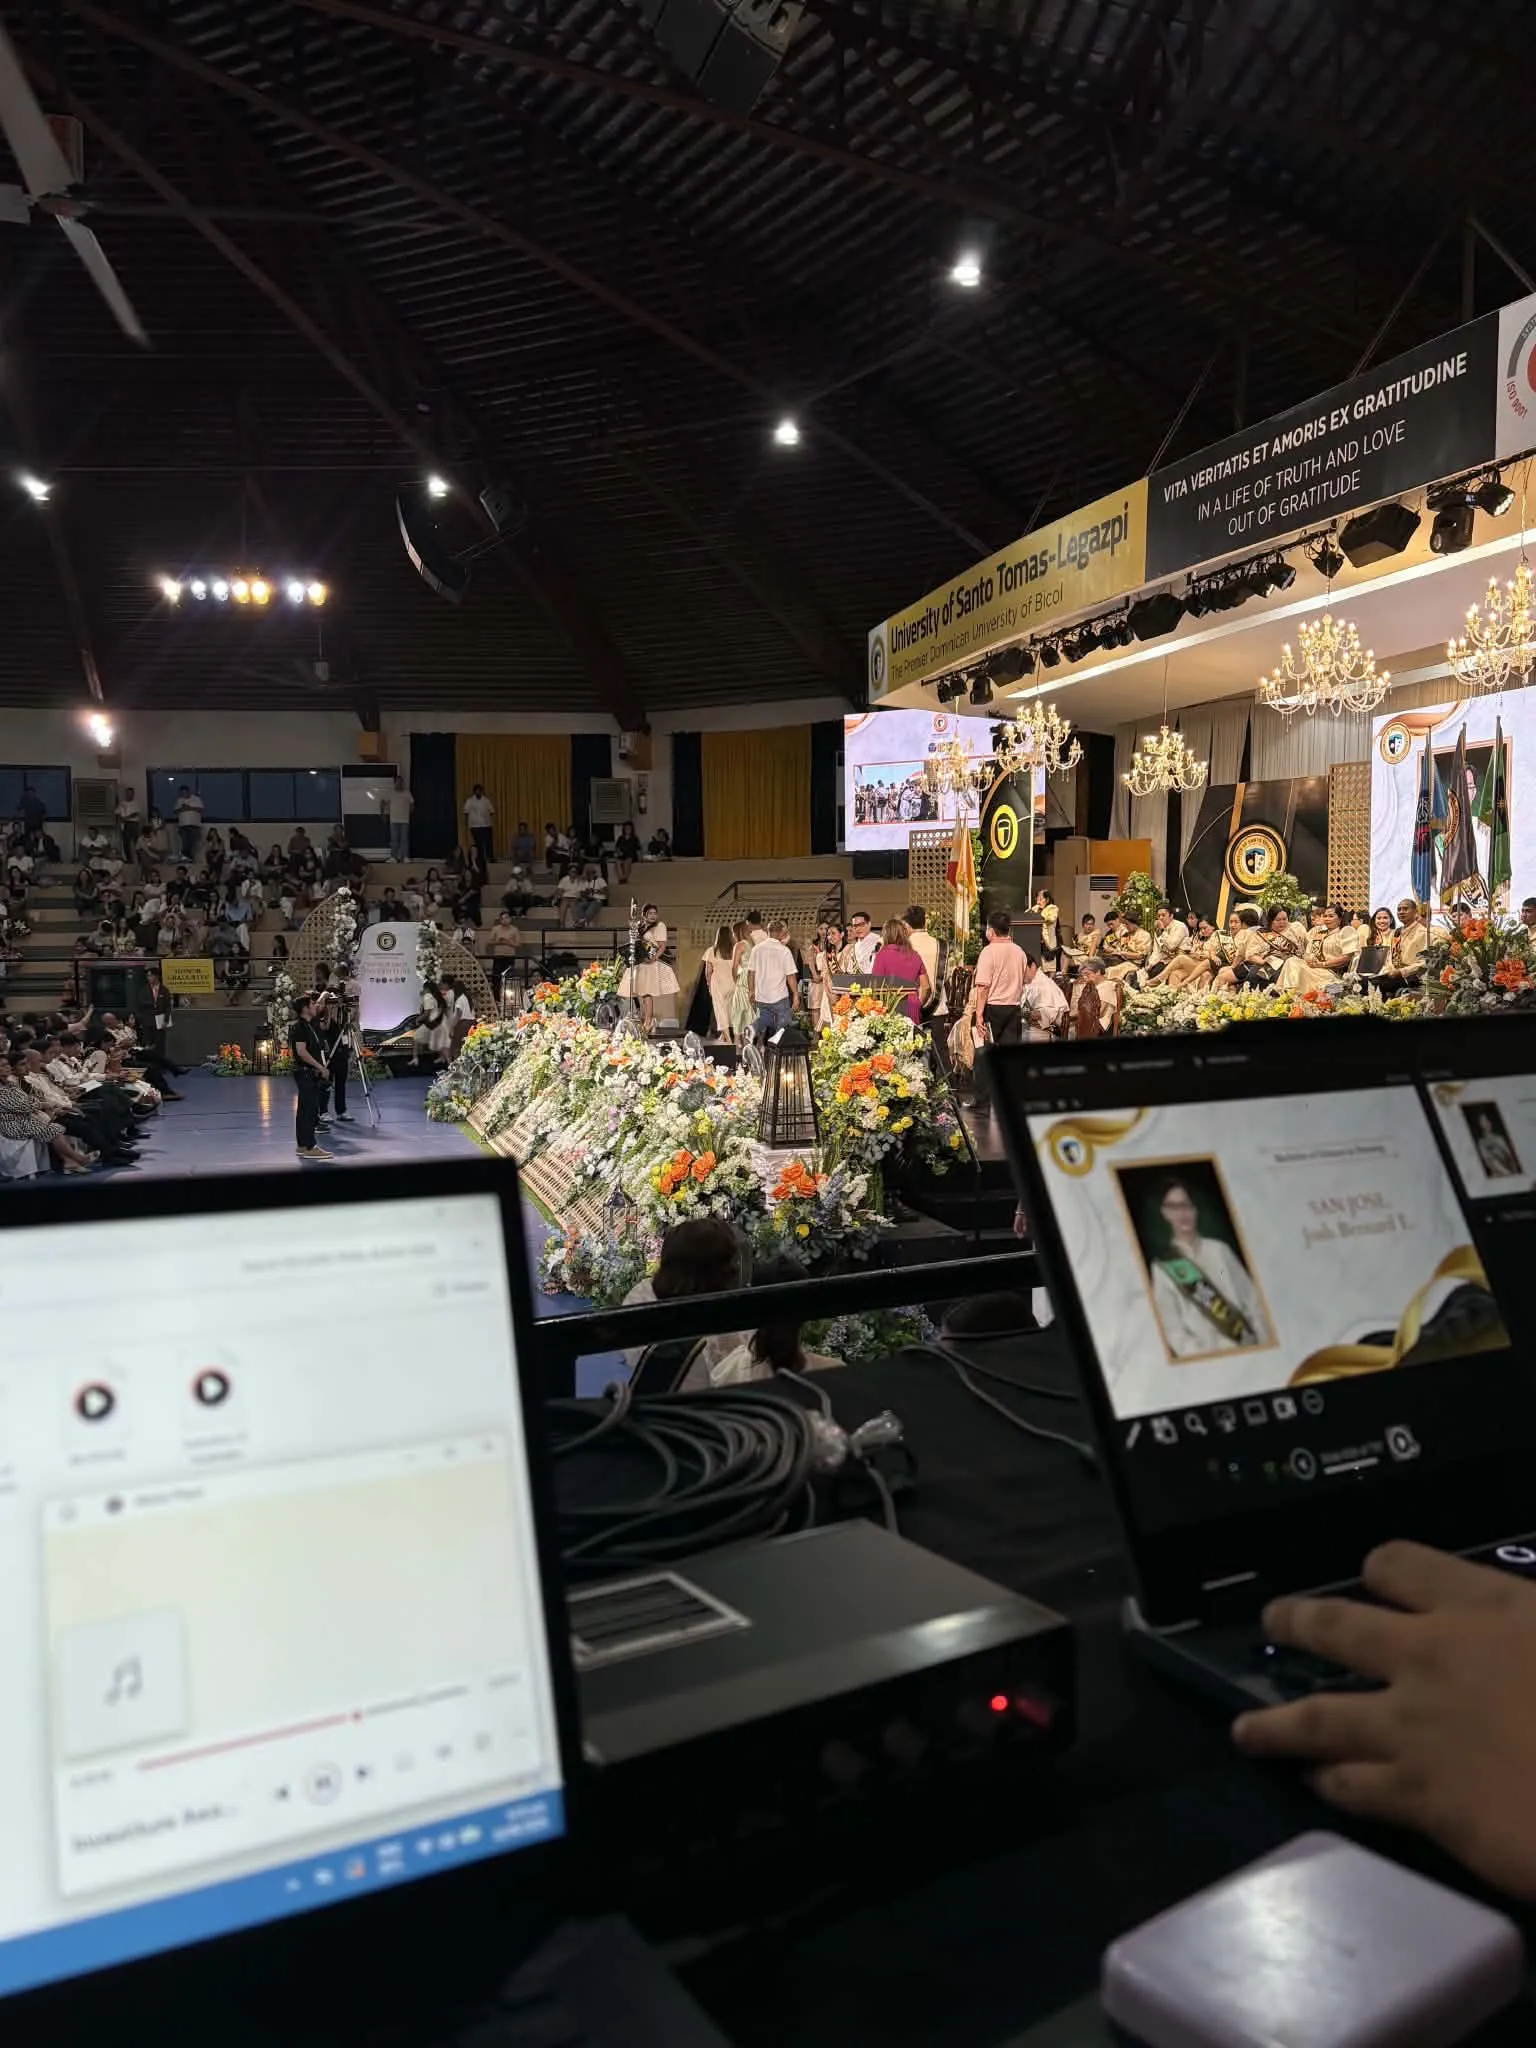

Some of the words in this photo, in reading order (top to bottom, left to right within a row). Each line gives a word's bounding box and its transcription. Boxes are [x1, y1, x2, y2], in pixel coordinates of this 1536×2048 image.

[1164, 480, 1188, 502] VITA
[1191, 451, 1250, 492] VERITATIS
[1253, 441, 1269, 464] ET
[1271, 415, 1327, 457] AMORIS
[1330, 405, 1349, 431] EX
[1353, 352, 1468, 420] GRATITUDINE
[1506, 381, 1517, 402] ISO
[1198, 501, 1210, 521] IN
[1213, 497, 1222, 516] A
[1225, 484, 1250, 511] LIFE
[1254, 475, 1272, 499] OF
[1275, 455, 1322, 491] TRUTH
[1325, 440, 1359, 472] AND
[1363, 419, 1406, 455] LOVE
[1228, 511, 1254, 536] OUT
[1257, 502, 1276, 526] OF
[1279, 469, 1361, 517] GRATITUDE
[891, 604, 940, 654] University
[942, 589, 956, 625] of
[956, 574, 994, 619] Santo
[996, 501, 1129, 593] Tomas-Legazpi
[891, 664, 903, 682] The
[904, 651, 928, 672] Premier
[929, 630, 970, 664] Dominican
[972, 606, 1017, 642] University
[1020, 597, 1033, 621] of
[1035, 582, 1063, 613] Bicol
